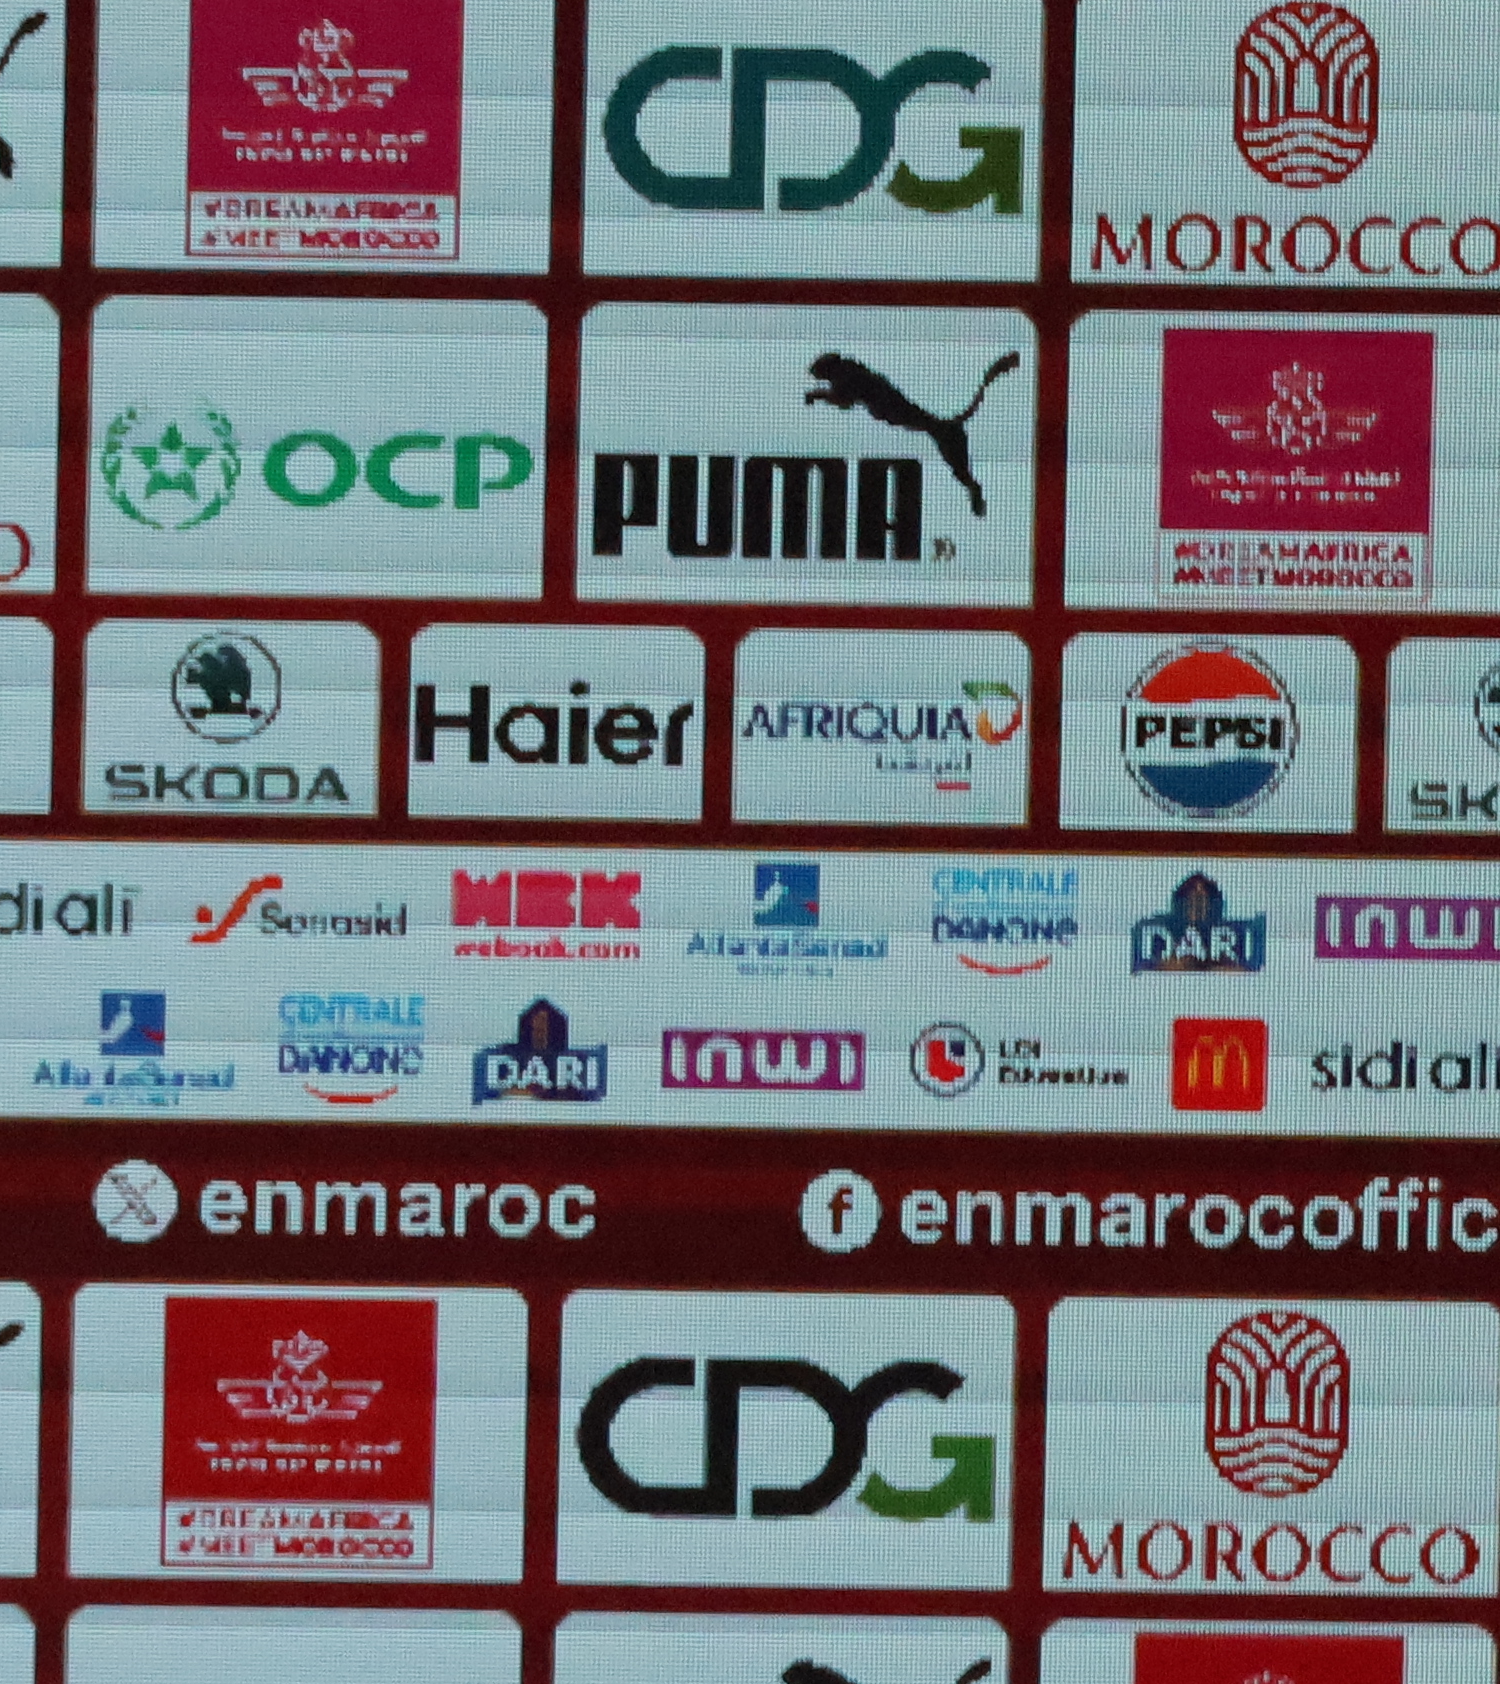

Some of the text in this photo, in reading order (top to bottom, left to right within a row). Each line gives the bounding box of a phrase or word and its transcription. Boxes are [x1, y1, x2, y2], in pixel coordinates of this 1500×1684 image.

[603, 46, 1023, 215] CDG
[1092, 214, 1500, 275] MOROCCO
[262, 431, 534, 510] OCP
[593, 453, 922, 561] PUMA
[408, 681, 693, 766] Haier
[743, 703, 971, 743] AFRIQUIA
[1136, 716, 1283, 749] PEPSI
[933, 869, 1077, 897] CENTRALE
[932, 915, 1078, 942] DANONE
[1144, 926, 1256, 964] DARI
[277, 992, 423, 1029] CENTRALE
[487, 1057, 597, 1092] DARI
[670, 1035, 857, 1085] inwi
[1313, 1041, 1417, 1090] sidi
[199, 1180, 595, 1239] enmaroc
[576, 1357, 994, 1522] CDG
[1064, 1523, 1480, 1584] MOROCCO
